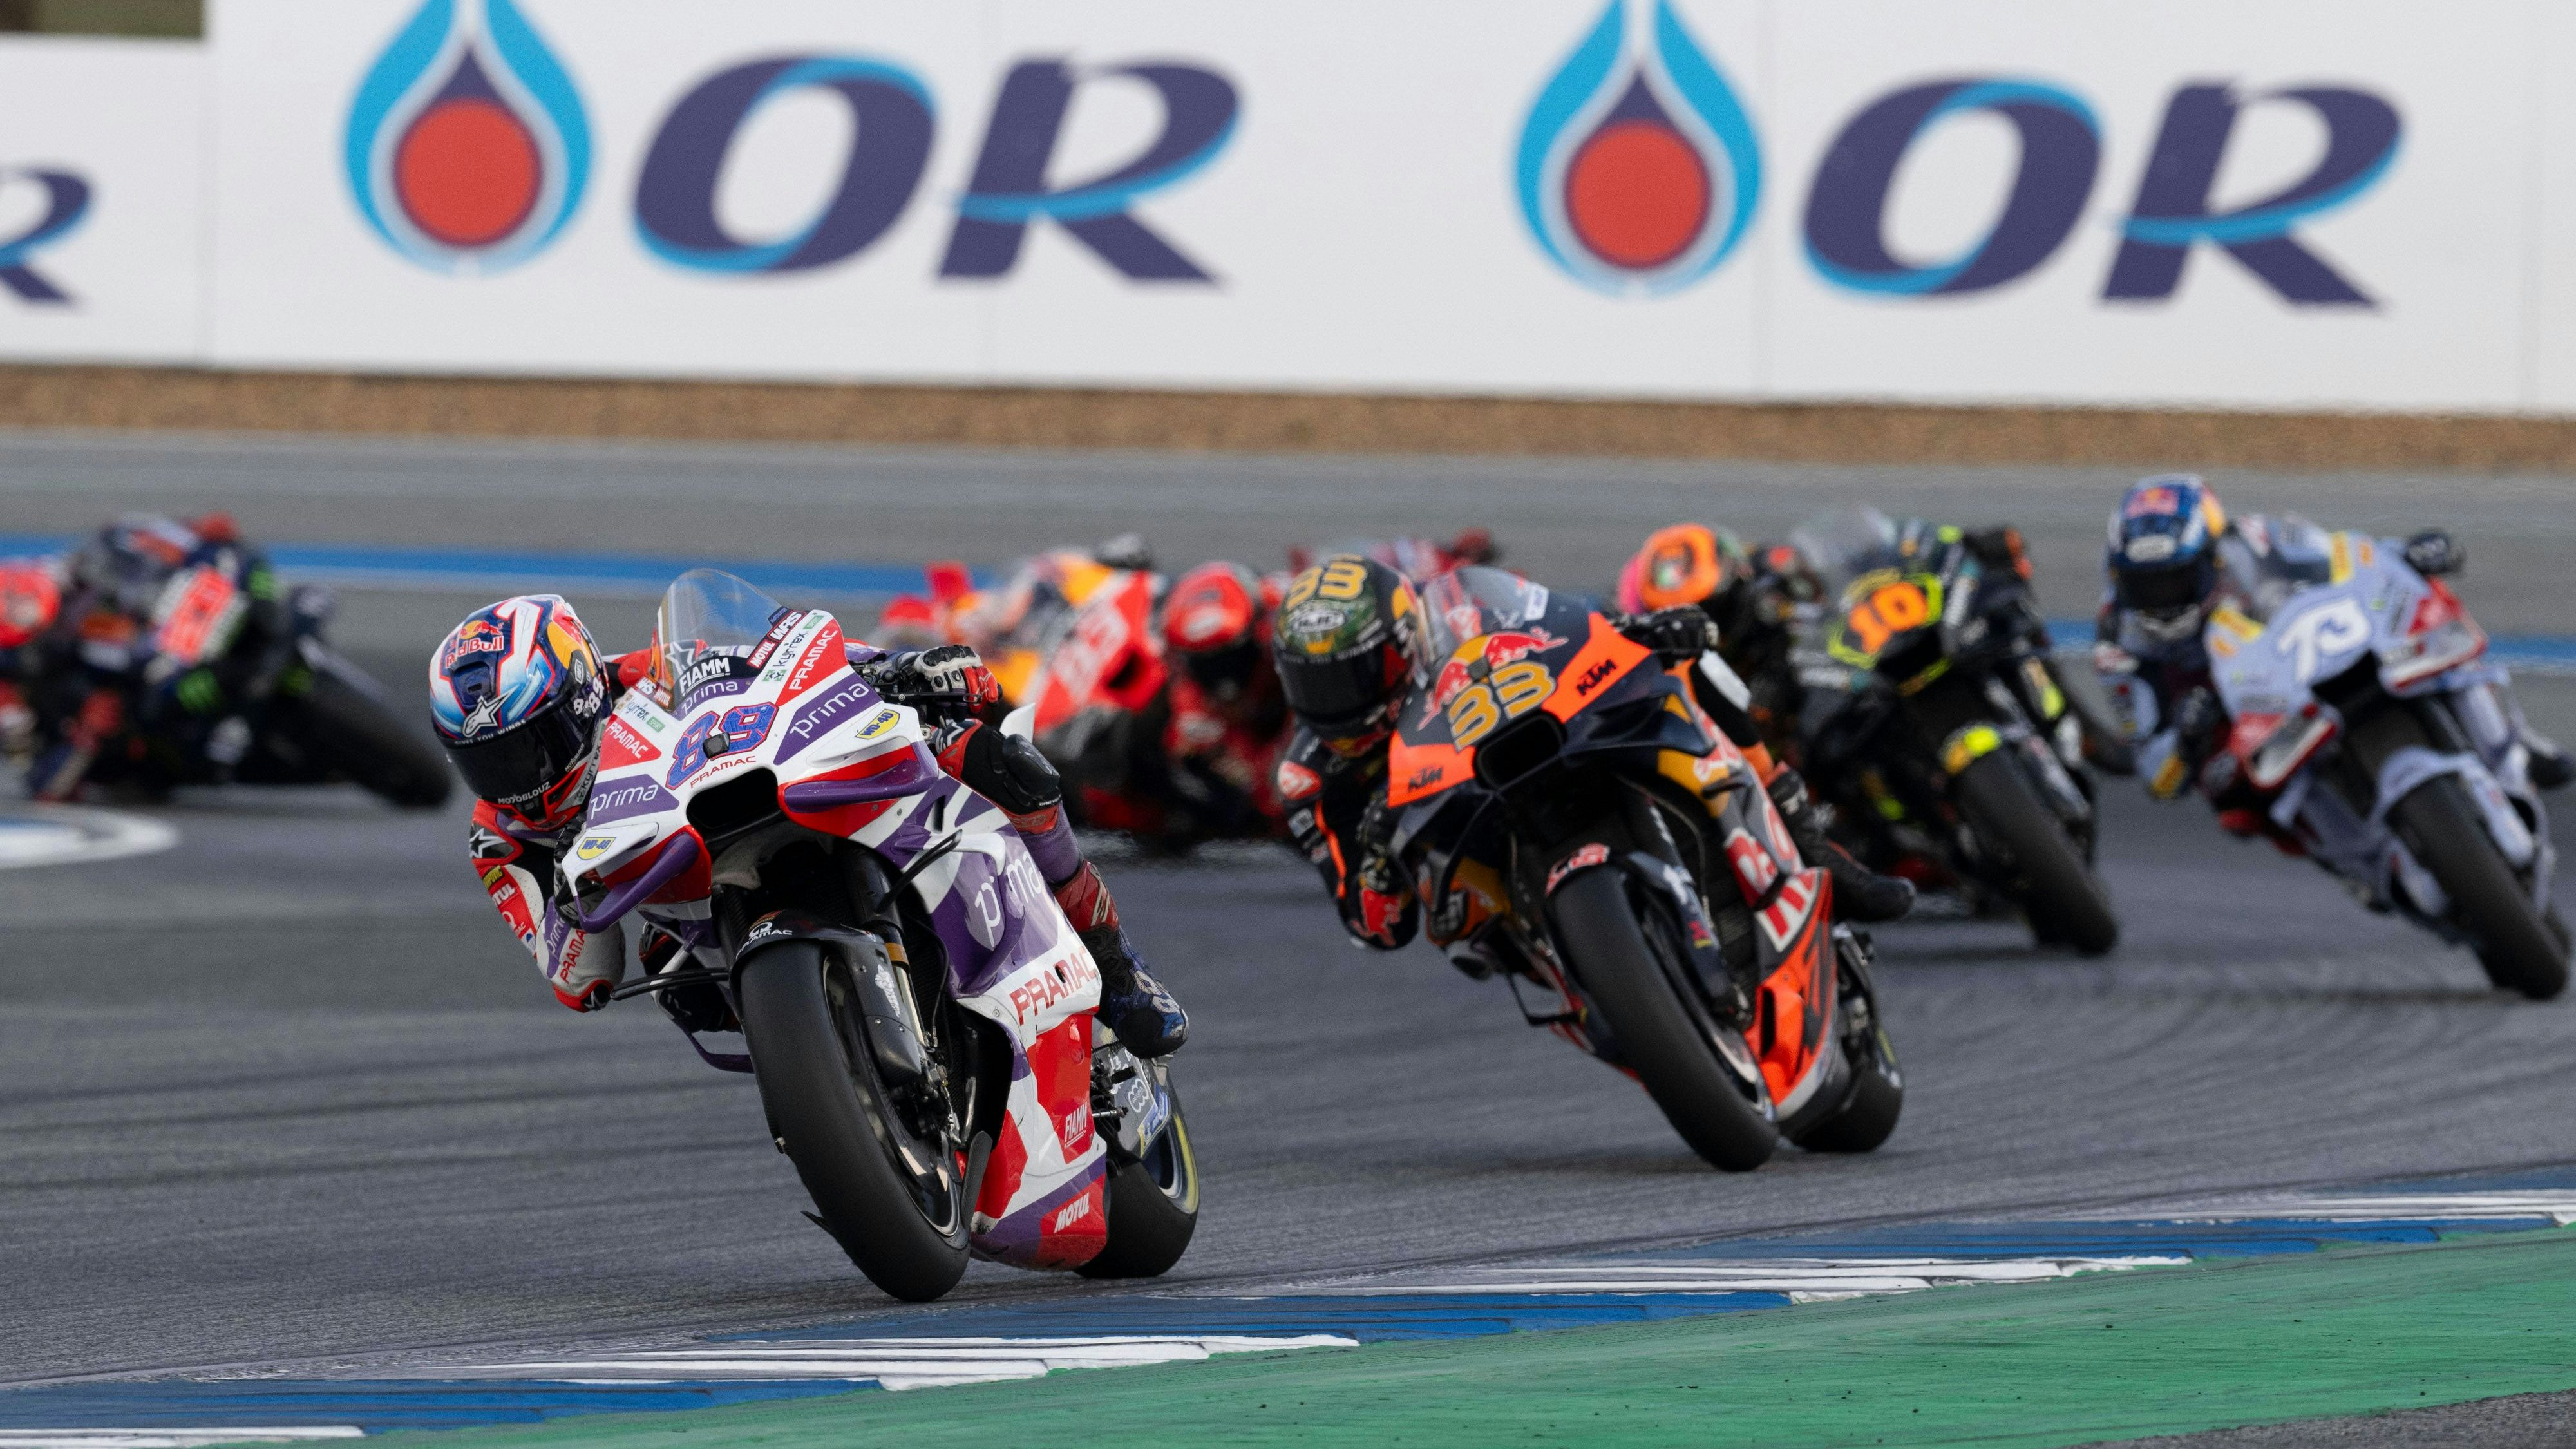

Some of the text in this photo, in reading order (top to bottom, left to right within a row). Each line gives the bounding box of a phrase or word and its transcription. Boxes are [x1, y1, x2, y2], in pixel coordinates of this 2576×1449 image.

[631, 48, 1243, 290] OR
[1799, 72, 2405, 314] OR
[770, 612, 802, 641] WRS
[2278, 598, 2371, 683] 73
[445, 636, 504, 669] Rd Bull
[750, 641, 775, 668] MOTUL
[789, 630, 837, 690] PRAMAC
[679, 657, 731, 695] FIAMM
[1577, 659, 1617, 696] KTM
[654, 687, 671, 707] MOTUL
[681, 681, 739, 715] prima
[790, 683, 869, 739] prima
[1448, 660, 1557, 753] 33
[477, 734, 494, 742] YOU
[497, 719, 526, 735] WINGS
[607, 721, 648, 759] PRAMAC
[861, 712, 894, 737] WD-40
[665, 701, 779, 790] 89
[690, 755, 757, 789] PRAMAC
[1408, 766, 1443, 793] KTM
[497, 781, 551, 805] MOTOBLOUZ
[591, 784, 659, 820] prima
[581, 838, 609, 851] WD-40
[974, 850, 1042, 950] pma
[560, 928, 587, 985] PRAMA
[1009, 945, 1096, 1027] PRAMAC
[1064, 1102, 1088, 1144] FIAMM
[1054, 1193, 1090, 1234] MOTUL
